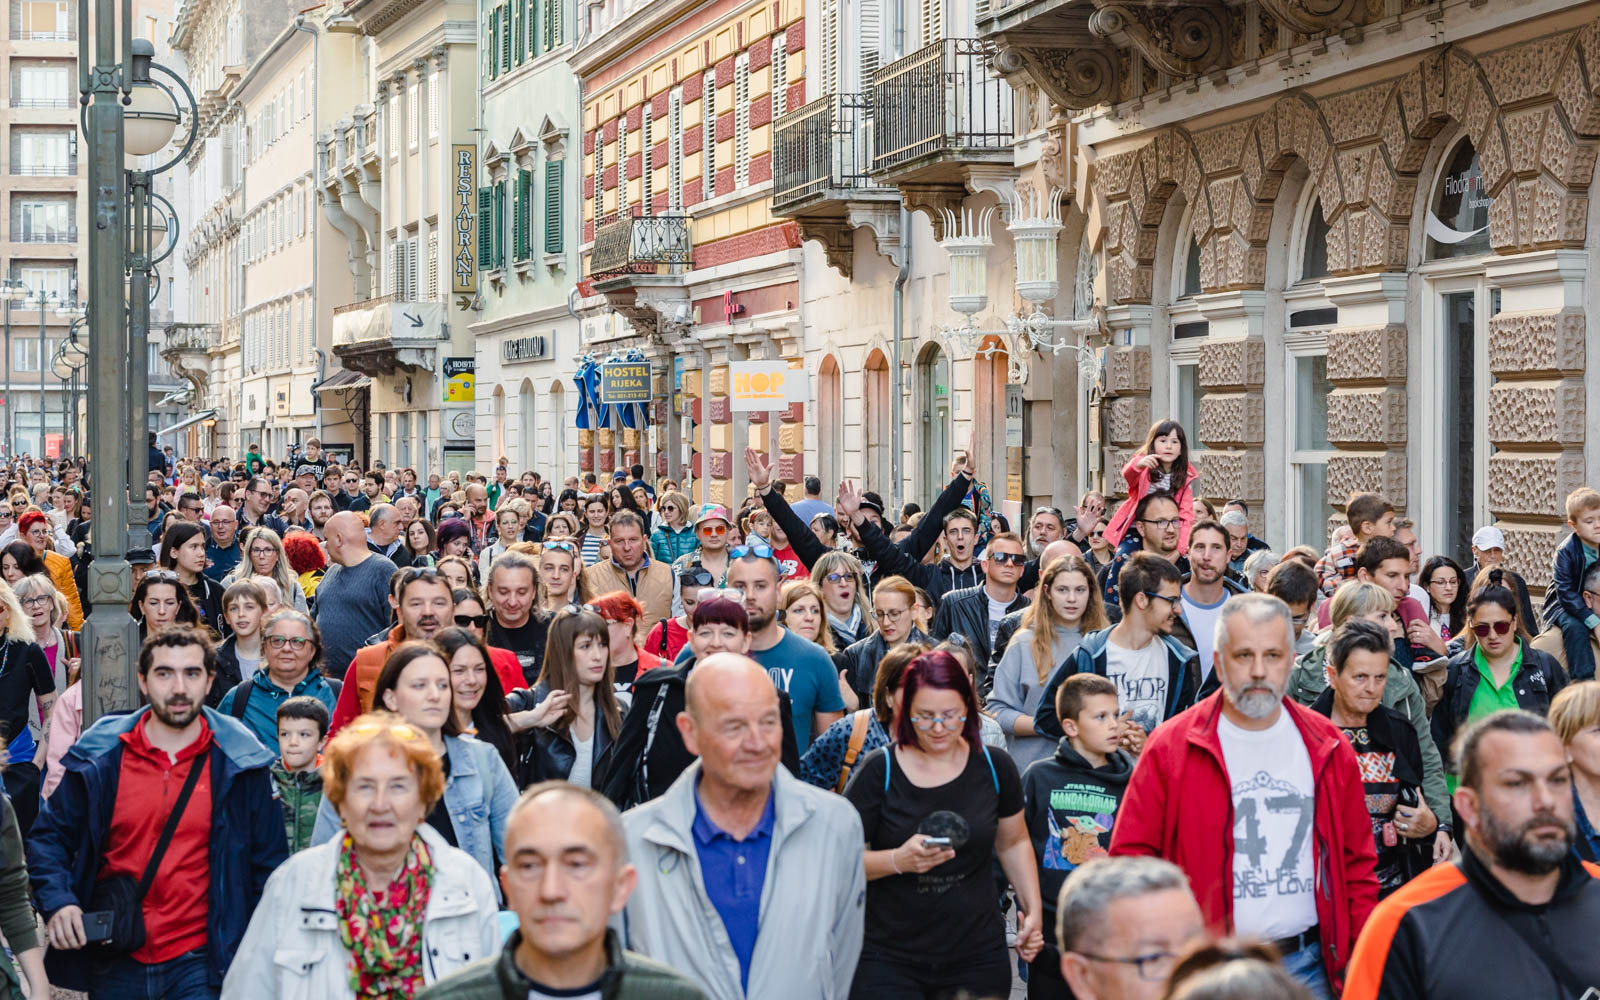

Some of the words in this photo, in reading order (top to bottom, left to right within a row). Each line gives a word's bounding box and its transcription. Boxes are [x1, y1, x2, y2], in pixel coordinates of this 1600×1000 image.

[1469, 195, 1489, 209] bookshop
[456, 151, 473, 287] RESTAURANT
[604, 367, 649, 377] HOSTEL
[611, 380, 642, 388] RIJEKA
[734, 372, 785, 393] HOP
[1064, 783, 1085, 791] STAR
[1085, 784, 1106, 793] WARS
[1050, 791, 1117, 813] MANDALORIAN
[1234, 792, 1315, 872] 47
[1277, 878, 1313, 895] LOVE
